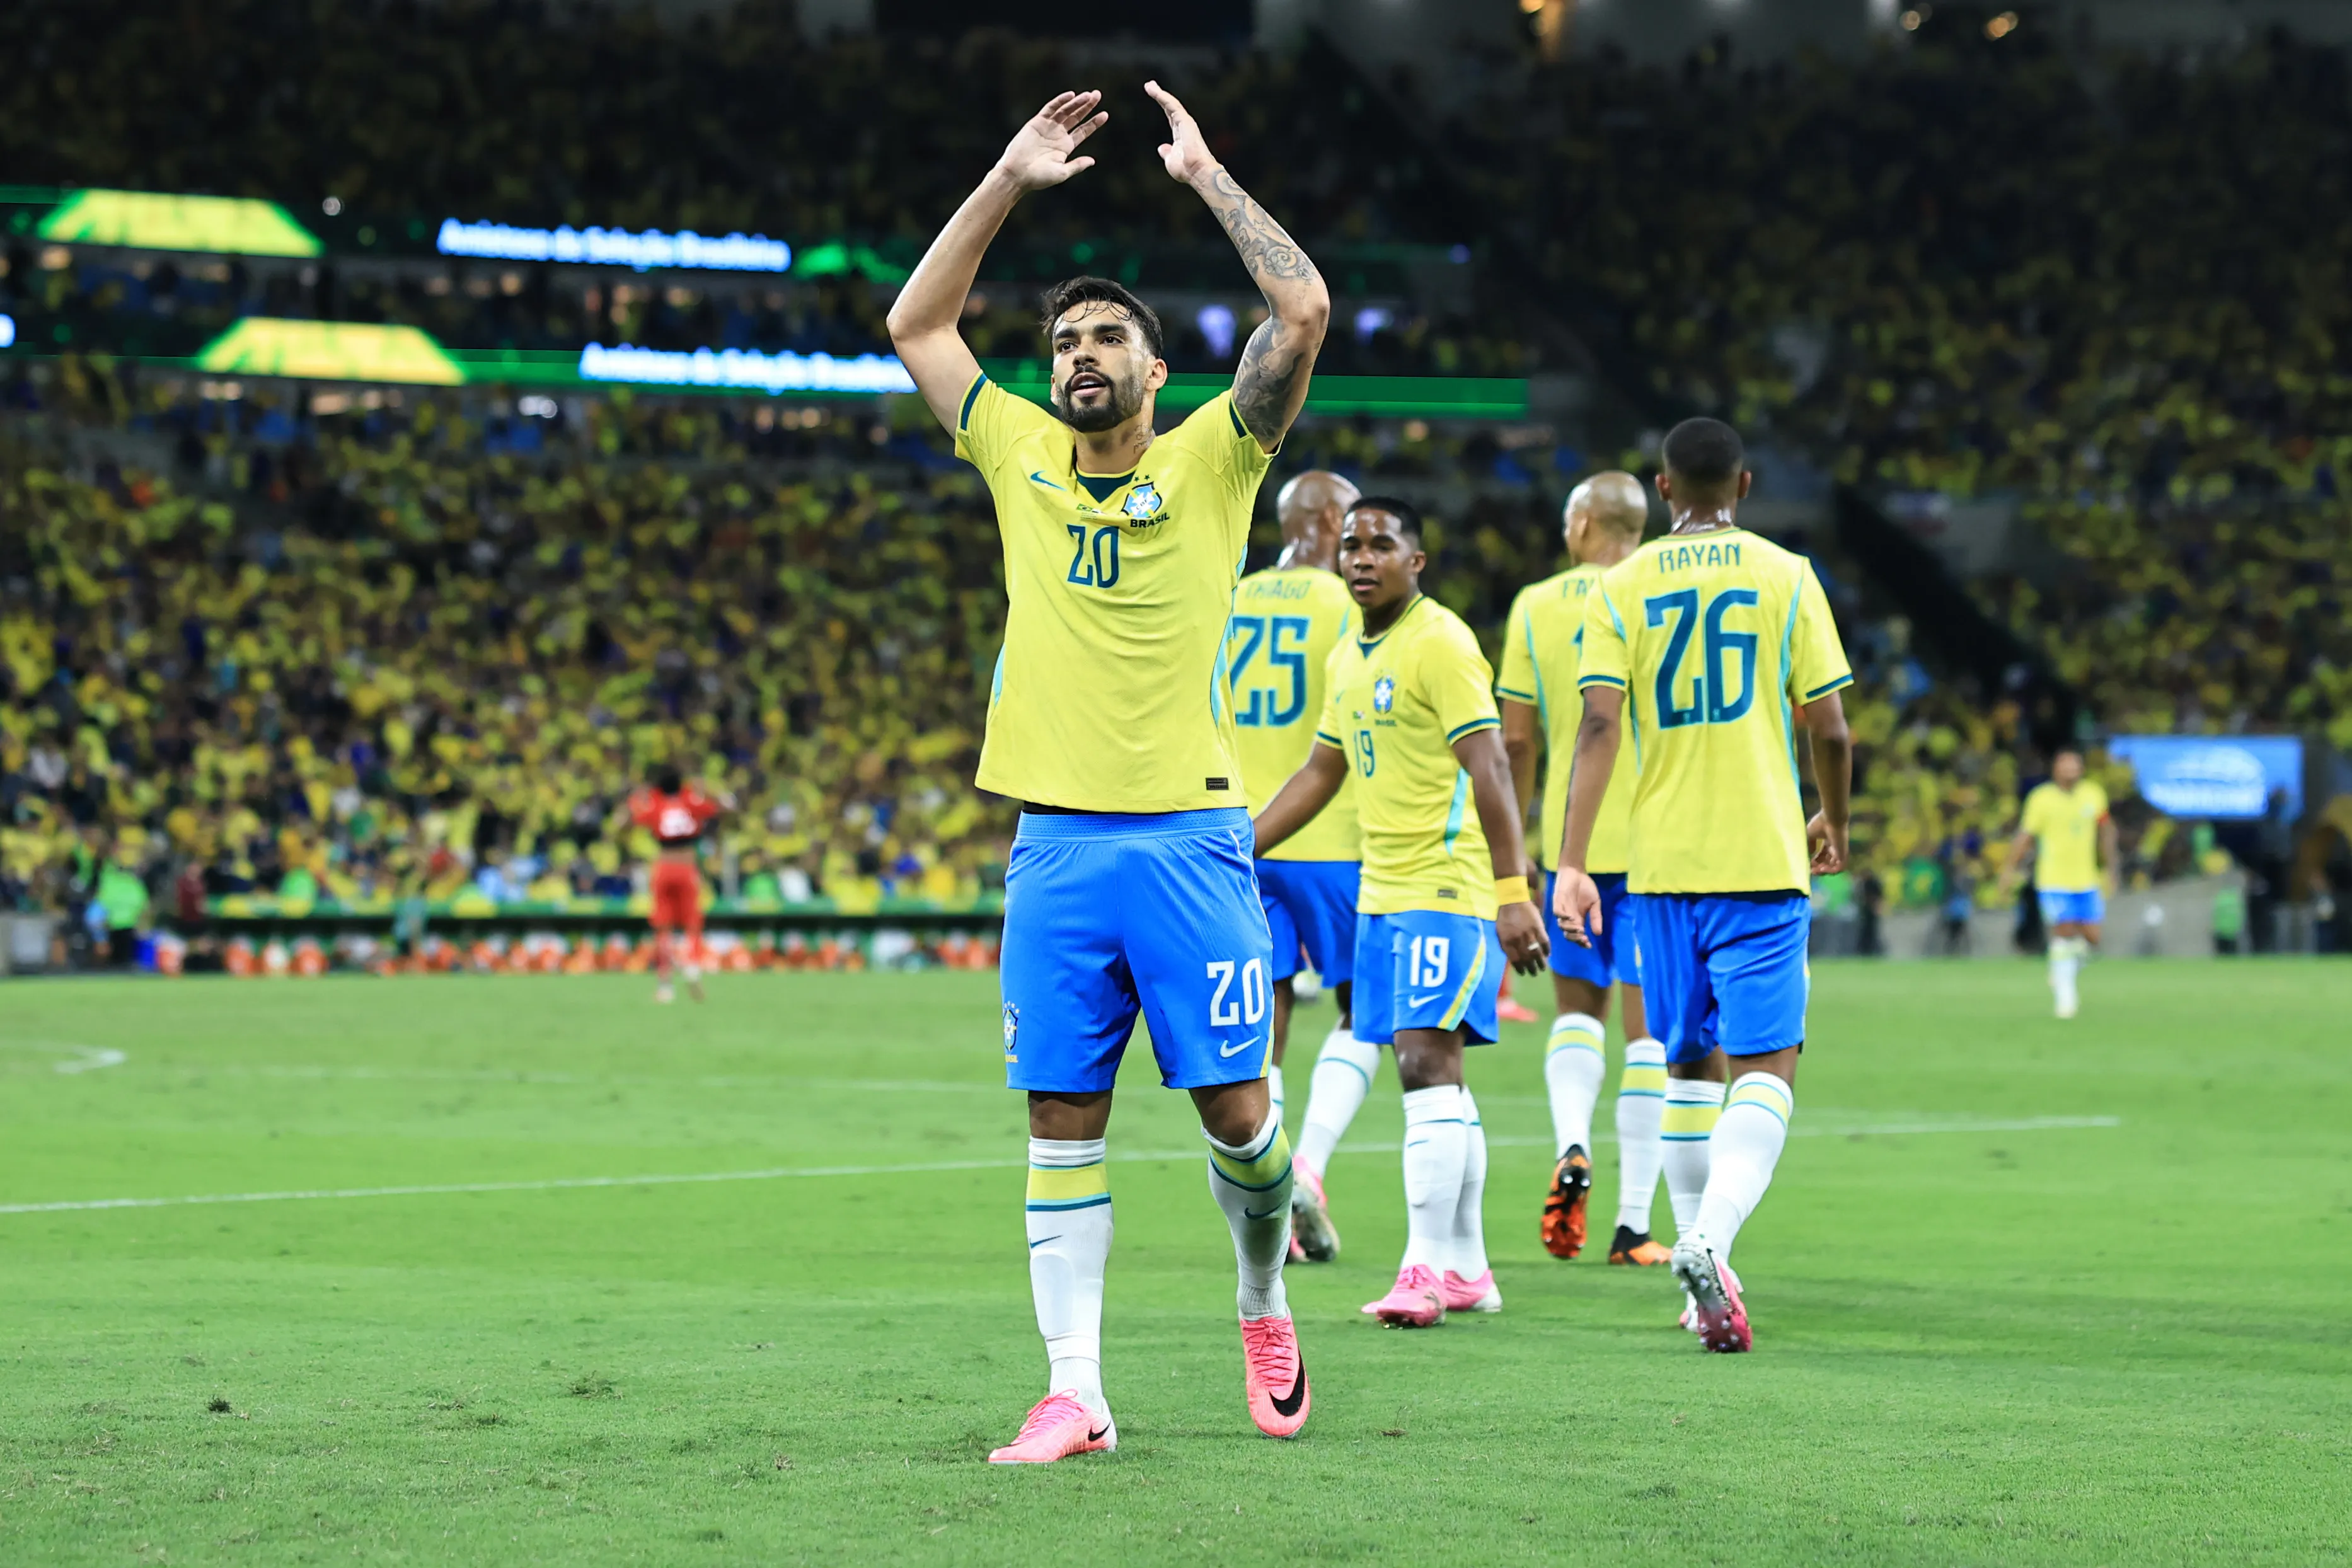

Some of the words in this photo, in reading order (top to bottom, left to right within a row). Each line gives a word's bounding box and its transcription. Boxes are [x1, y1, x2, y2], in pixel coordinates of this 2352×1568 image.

[1131, 512, 1170, 528] BRASIL
[1066, 524, 1119, 589] 20
[1659, 543, 1740, 573] RAYAN
[1230, 615, 1310, 727] 25
[1644, 587, 1758, 730] 26
[1353, 729, 1375, 778] 19
[1410, 935, 1450, 988] 19
[1206, 957, 1265, 1027] 20
